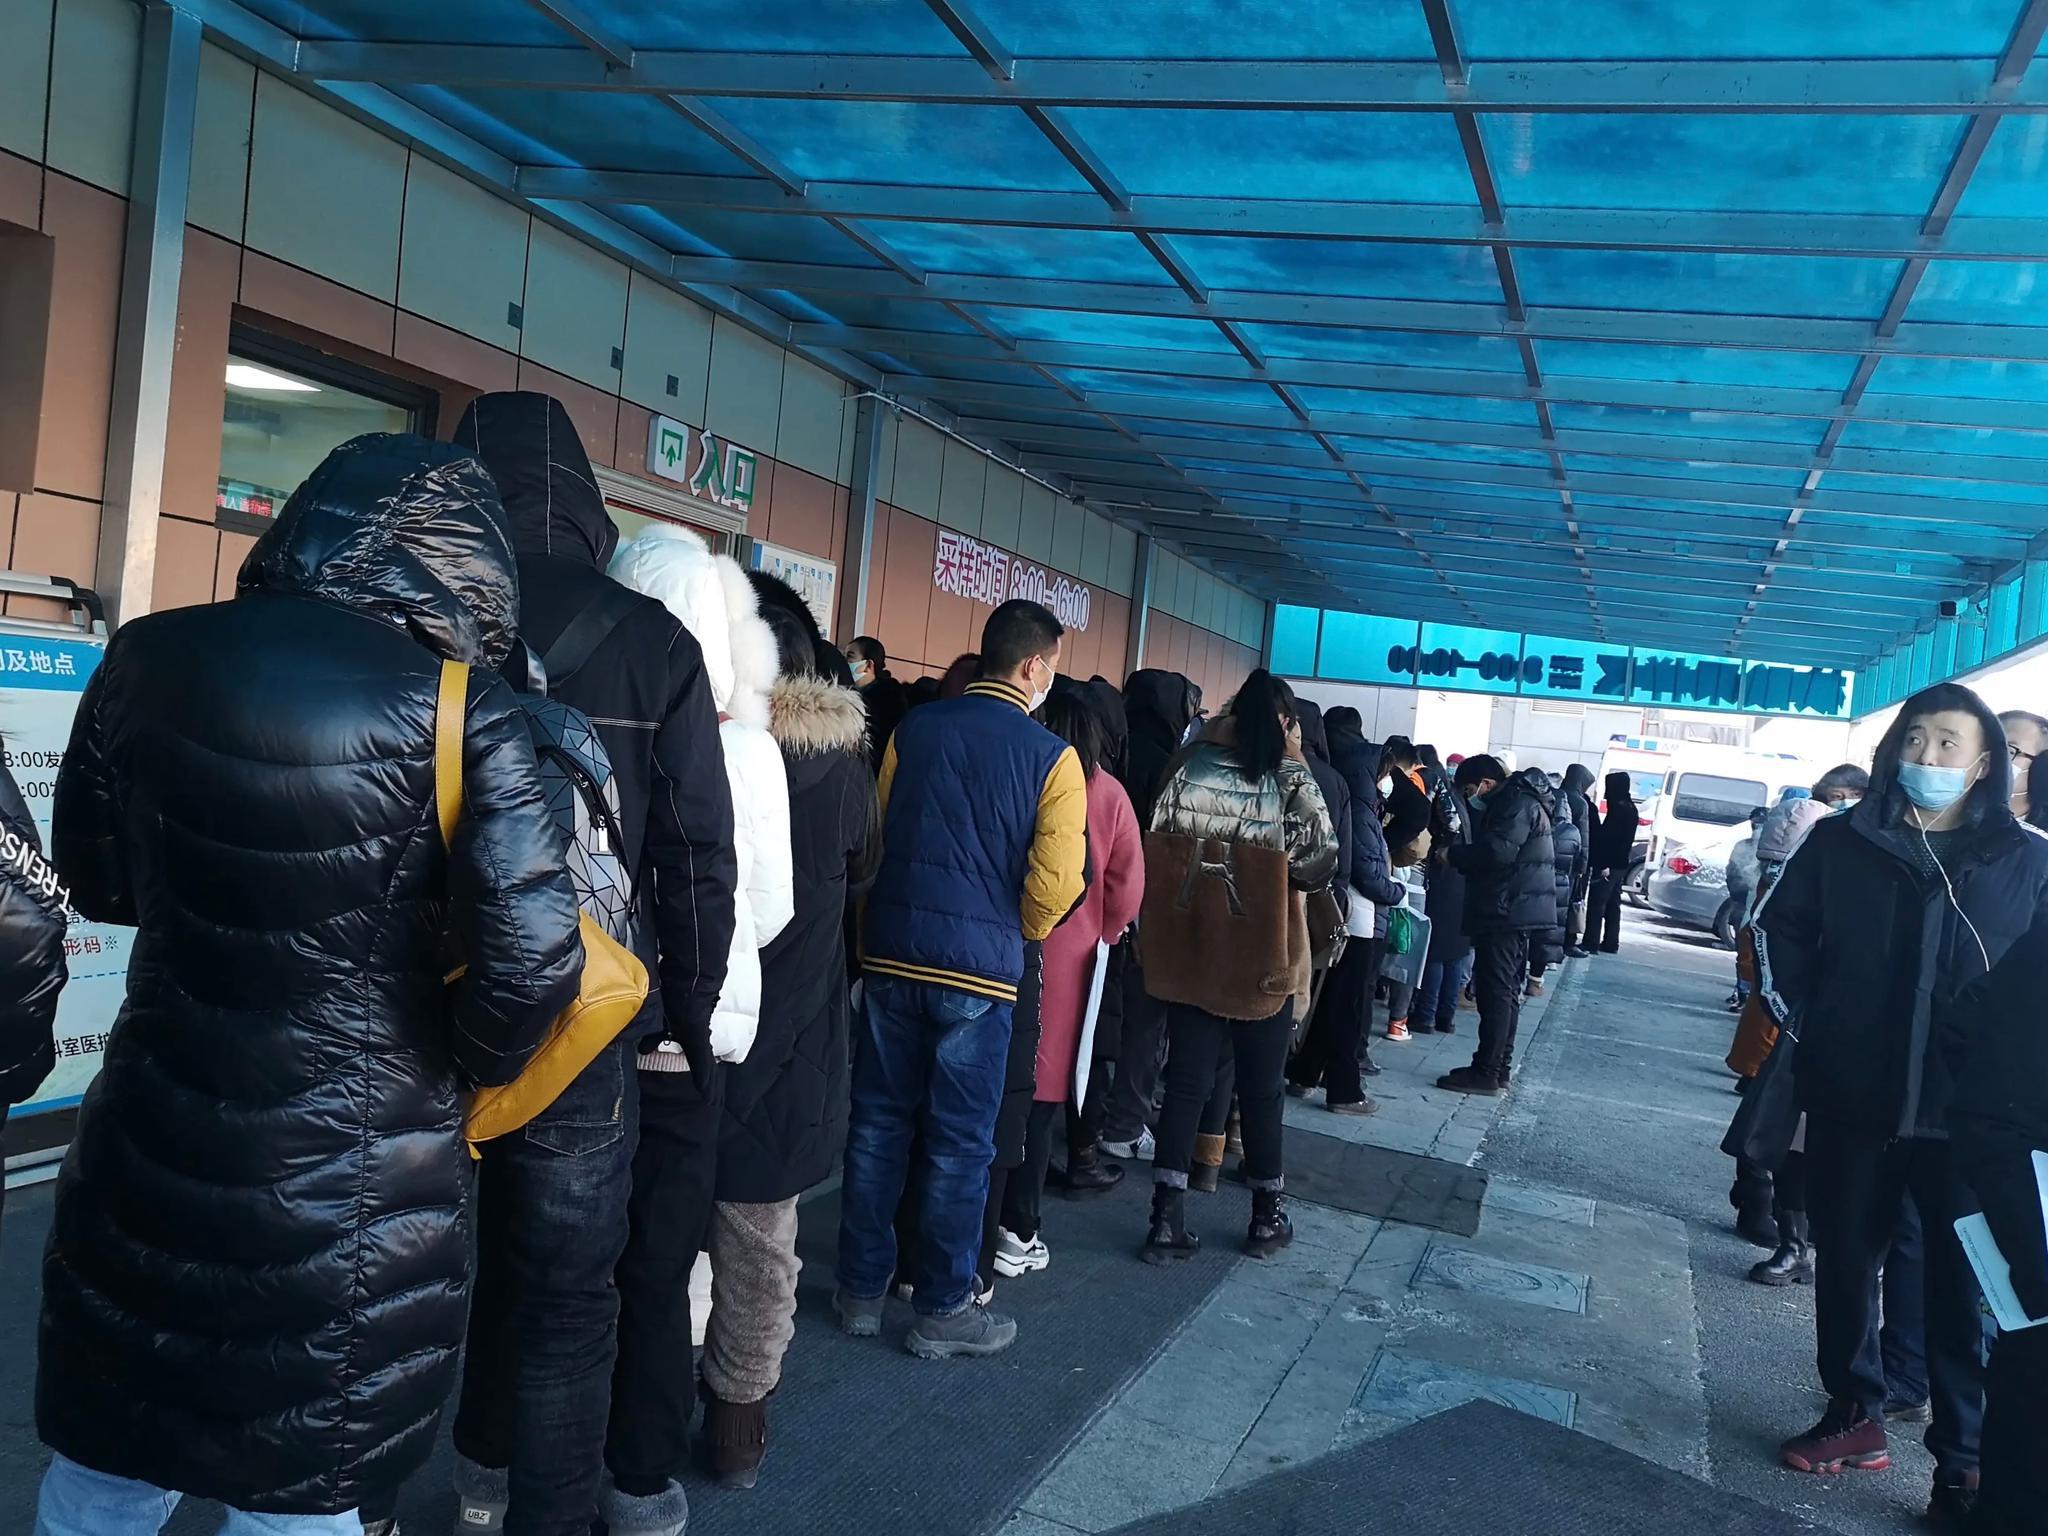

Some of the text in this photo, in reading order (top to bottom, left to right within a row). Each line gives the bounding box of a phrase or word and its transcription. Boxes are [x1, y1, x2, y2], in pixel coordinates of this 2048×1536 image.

[689, 429, 757, 513] 入口
[933, 530, 1010, 607] 采样时间
[3, 750, 66, 769] 8:00发
